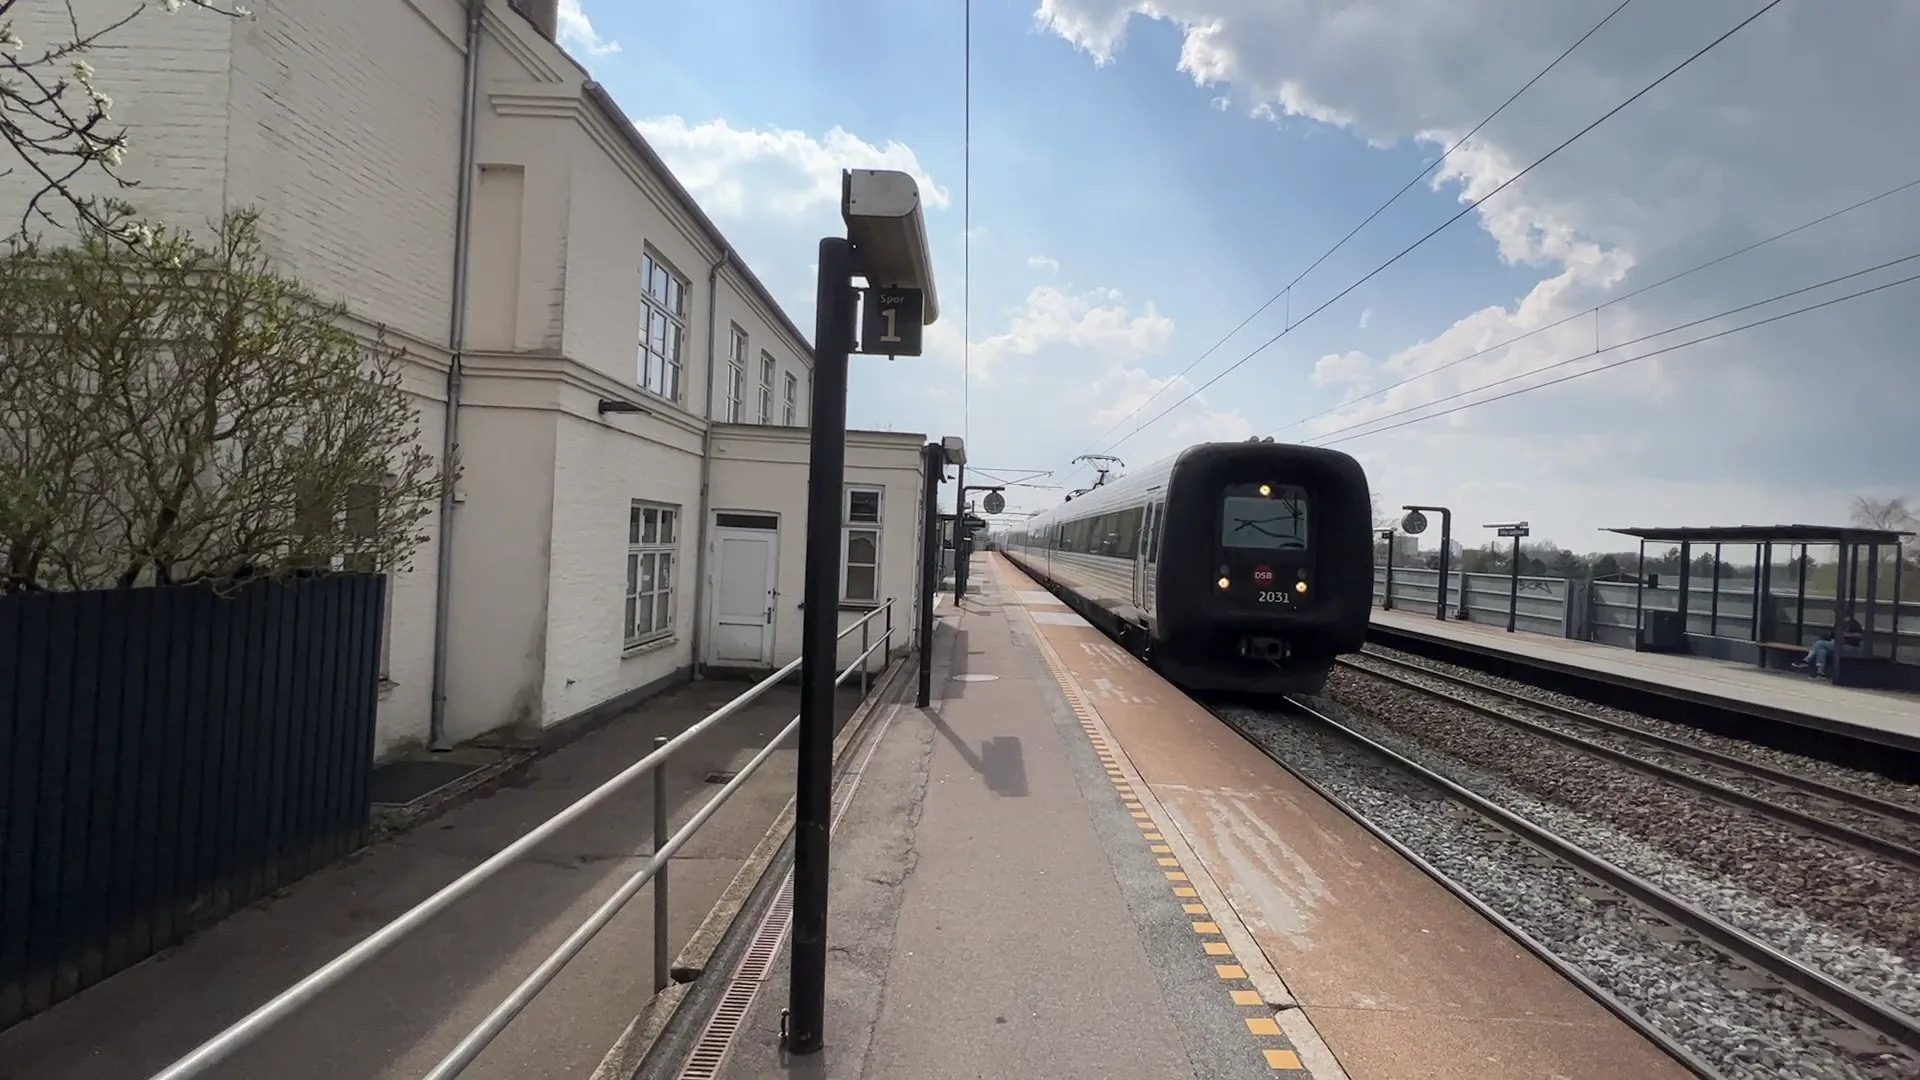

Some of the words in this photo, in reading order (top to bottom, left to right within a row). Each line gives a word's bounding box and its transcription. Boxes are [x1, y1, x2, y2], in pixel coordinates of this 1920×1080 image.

[880, 294, 905, 305] Spor
[880, 308, 902, 342] 1
[1254, 571, 1273, 579] DSB
[1258, 590, 1290, 604] 2031
